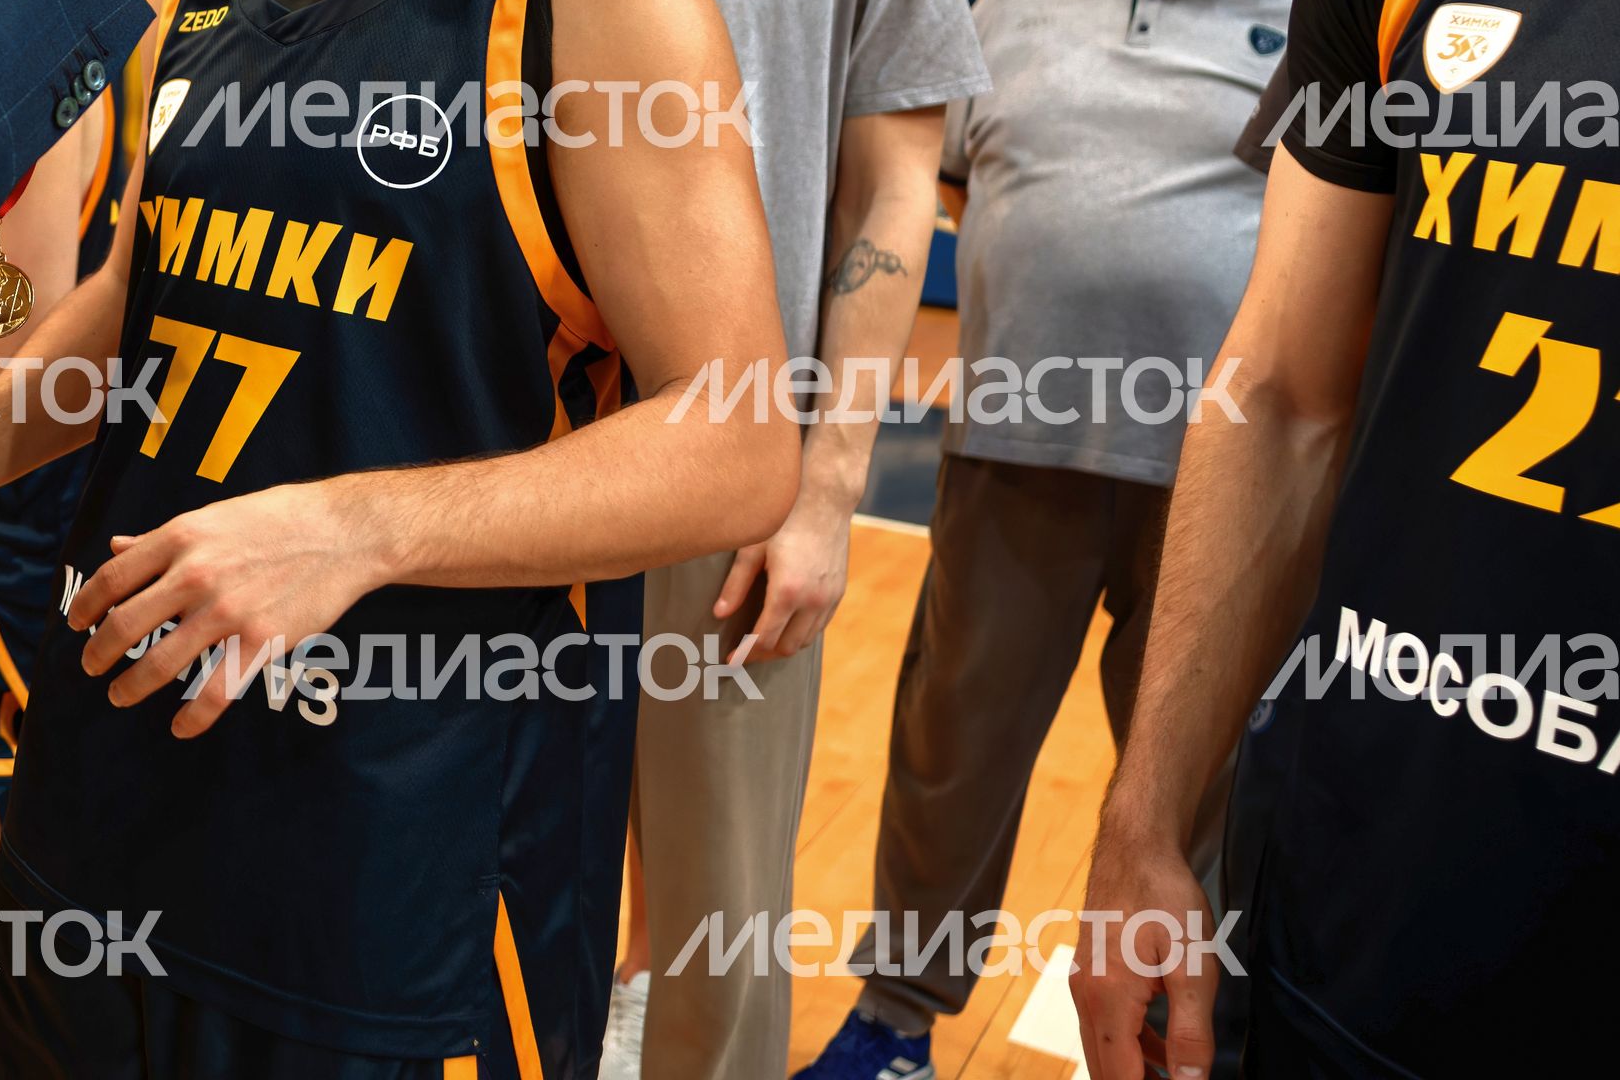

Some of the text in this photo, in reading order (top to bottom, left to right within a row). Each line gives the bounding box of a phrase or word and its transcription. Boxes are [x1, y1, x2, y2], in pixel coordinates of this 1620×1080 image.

[178, 5, 229, 33] ZEDO
[368, 123, 441, 158] РФБ
[139, 314, 302, 484] 77
[1449, 311, 1620, 529] 2
